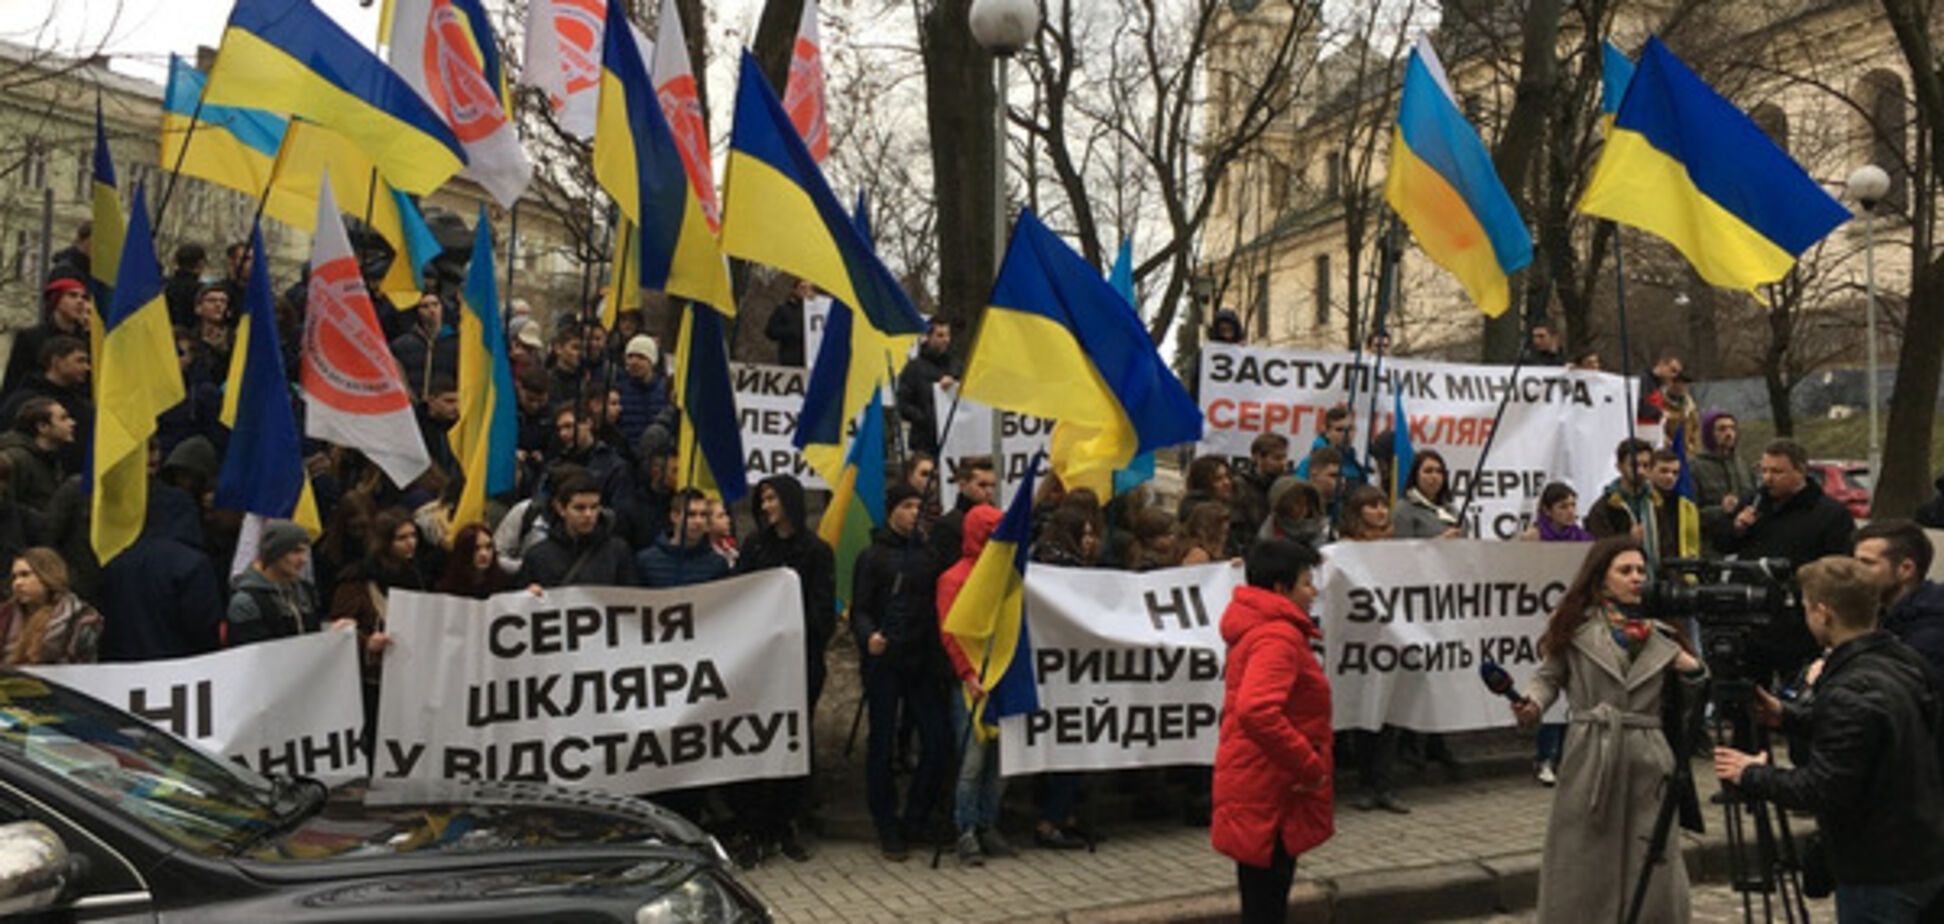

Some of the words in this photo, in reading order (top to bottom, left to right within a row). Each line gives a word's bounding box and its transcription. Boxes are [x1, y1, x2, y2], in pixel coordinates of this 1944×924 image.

[1209, 354, 1438, 399] ЗАСТУПНИК
[1445, 374, 1593, 407] МІНІСТРА
[488, 602, 695, 659] СЕРГІЯ
[1144, 586, 1210, 630] НІ
[1036, 647, 1225, 685] РИШУВ
[1337, 640, 1473, 675] ДОСИТЬ
[1480, 635, 1544, 665] КРА
[129, 680, 212, 739] НІ
[467, 659, 728, 728] ШКЛЯРА
[383, 739, 426, 778] У
[443, 711, 800, 783] ВІДСТАВКУ!
[1026, 697, 1225, 748] РЕЙДЕР
